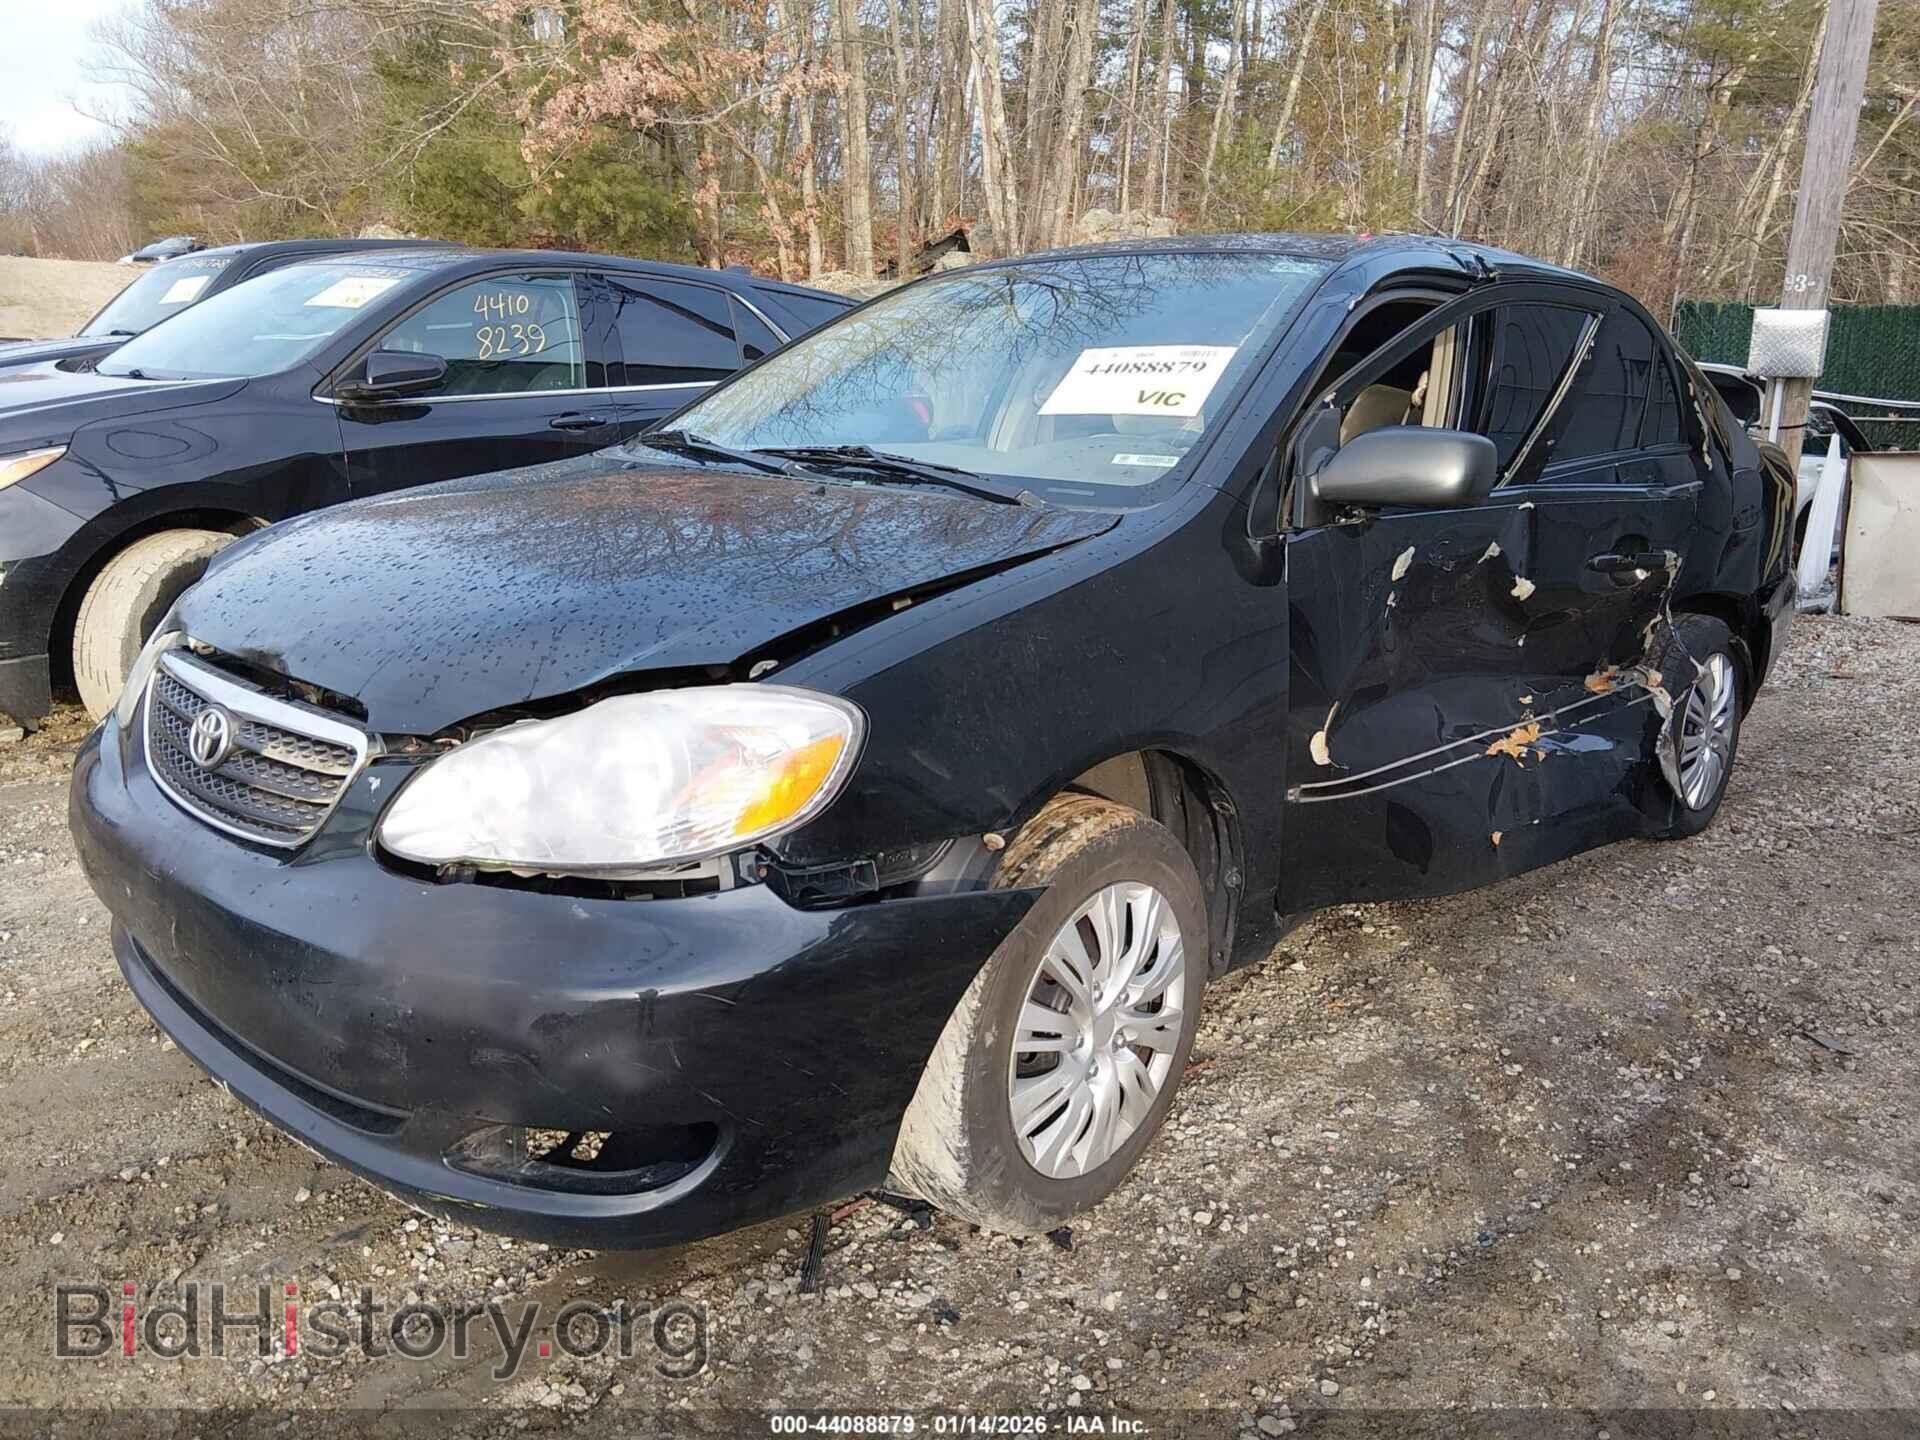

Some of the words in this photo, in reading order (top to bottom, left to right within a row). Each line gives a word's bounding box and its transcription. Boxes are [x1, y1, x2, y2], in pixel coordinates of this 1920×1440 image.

[473, 293, 529, 320] 4410
[476, 324, 546, 360] 8239
[1085, 361, 1208, 375] 44088879
[1137, 390, 1186, 407] VIC
